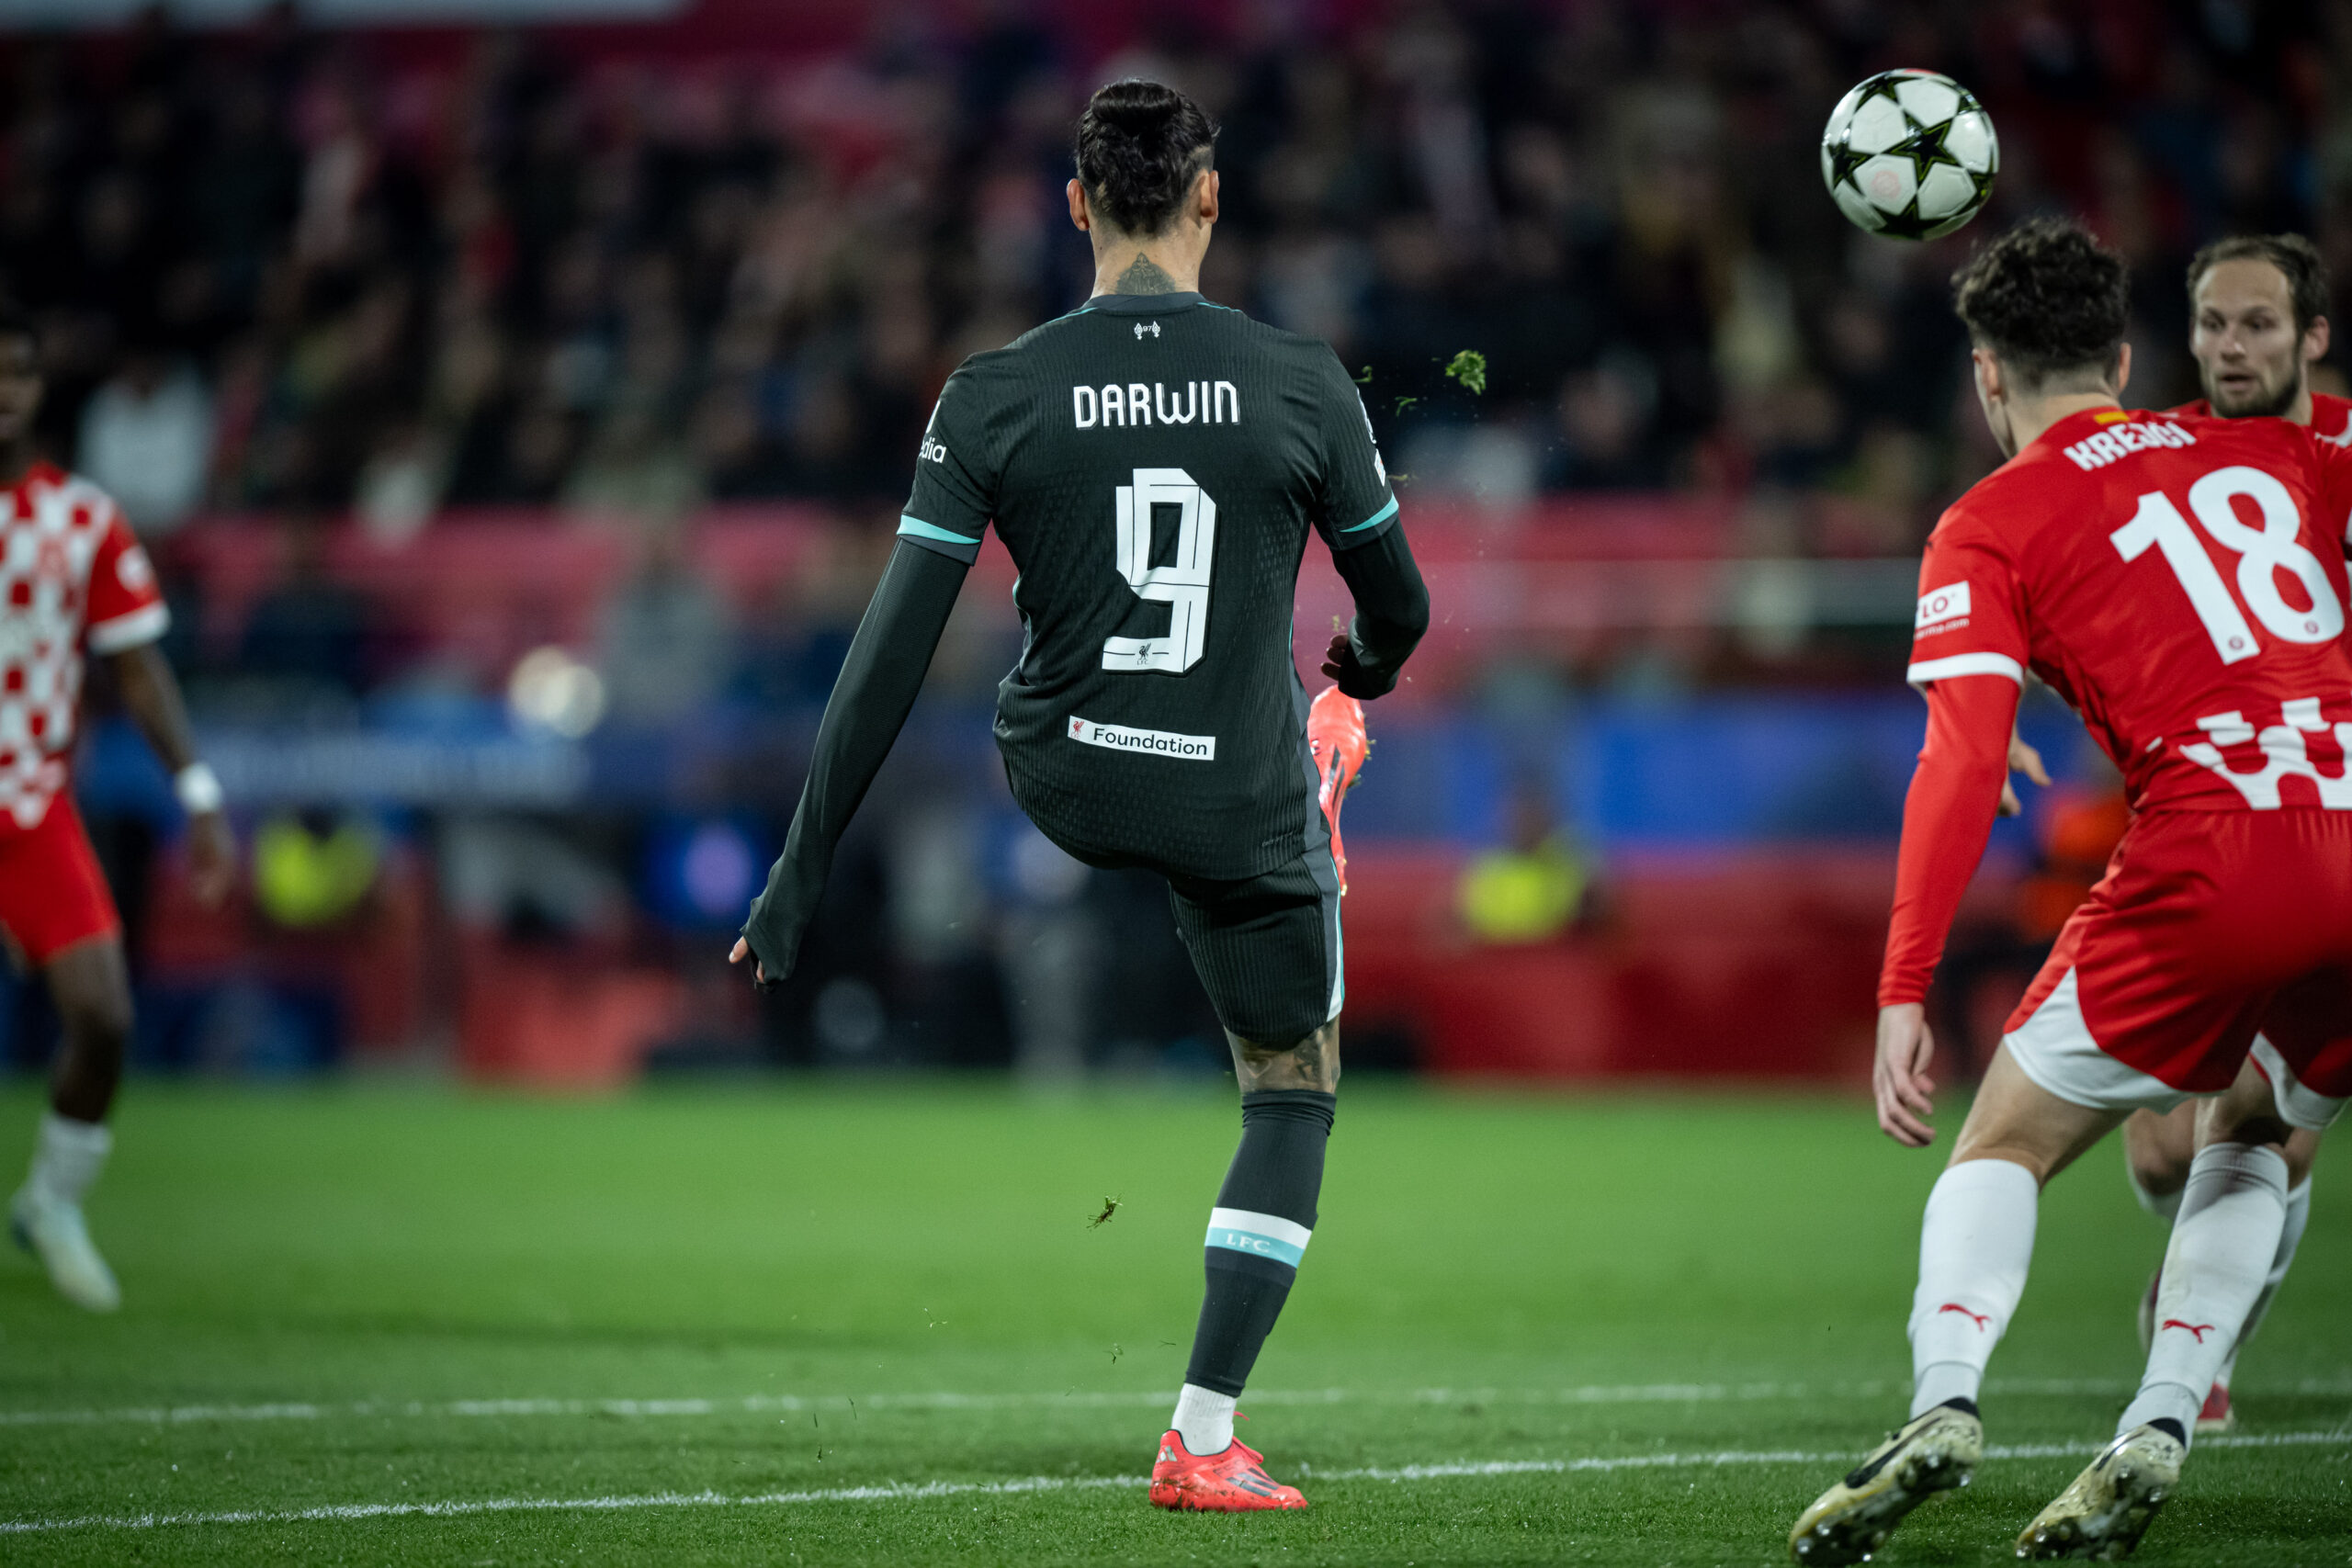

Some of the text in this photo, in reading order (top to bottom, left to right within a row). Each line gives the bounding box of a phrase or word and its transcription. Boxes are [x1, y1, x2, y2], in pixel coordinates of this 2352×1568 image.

[1073, 381, 1239, 429] DARWIN
[919, 436, 946, 463] dia
[2064, 421, 2197, 471] KREJCI
[1102, 468, 1216, 673] 9
[2109, 466, 2345, 665] 18
[1917, 595, 1949, 620] LO
[1093, 728, 1207, 756] Foundation
[1226, 1233, 1271, 1253] LFC
